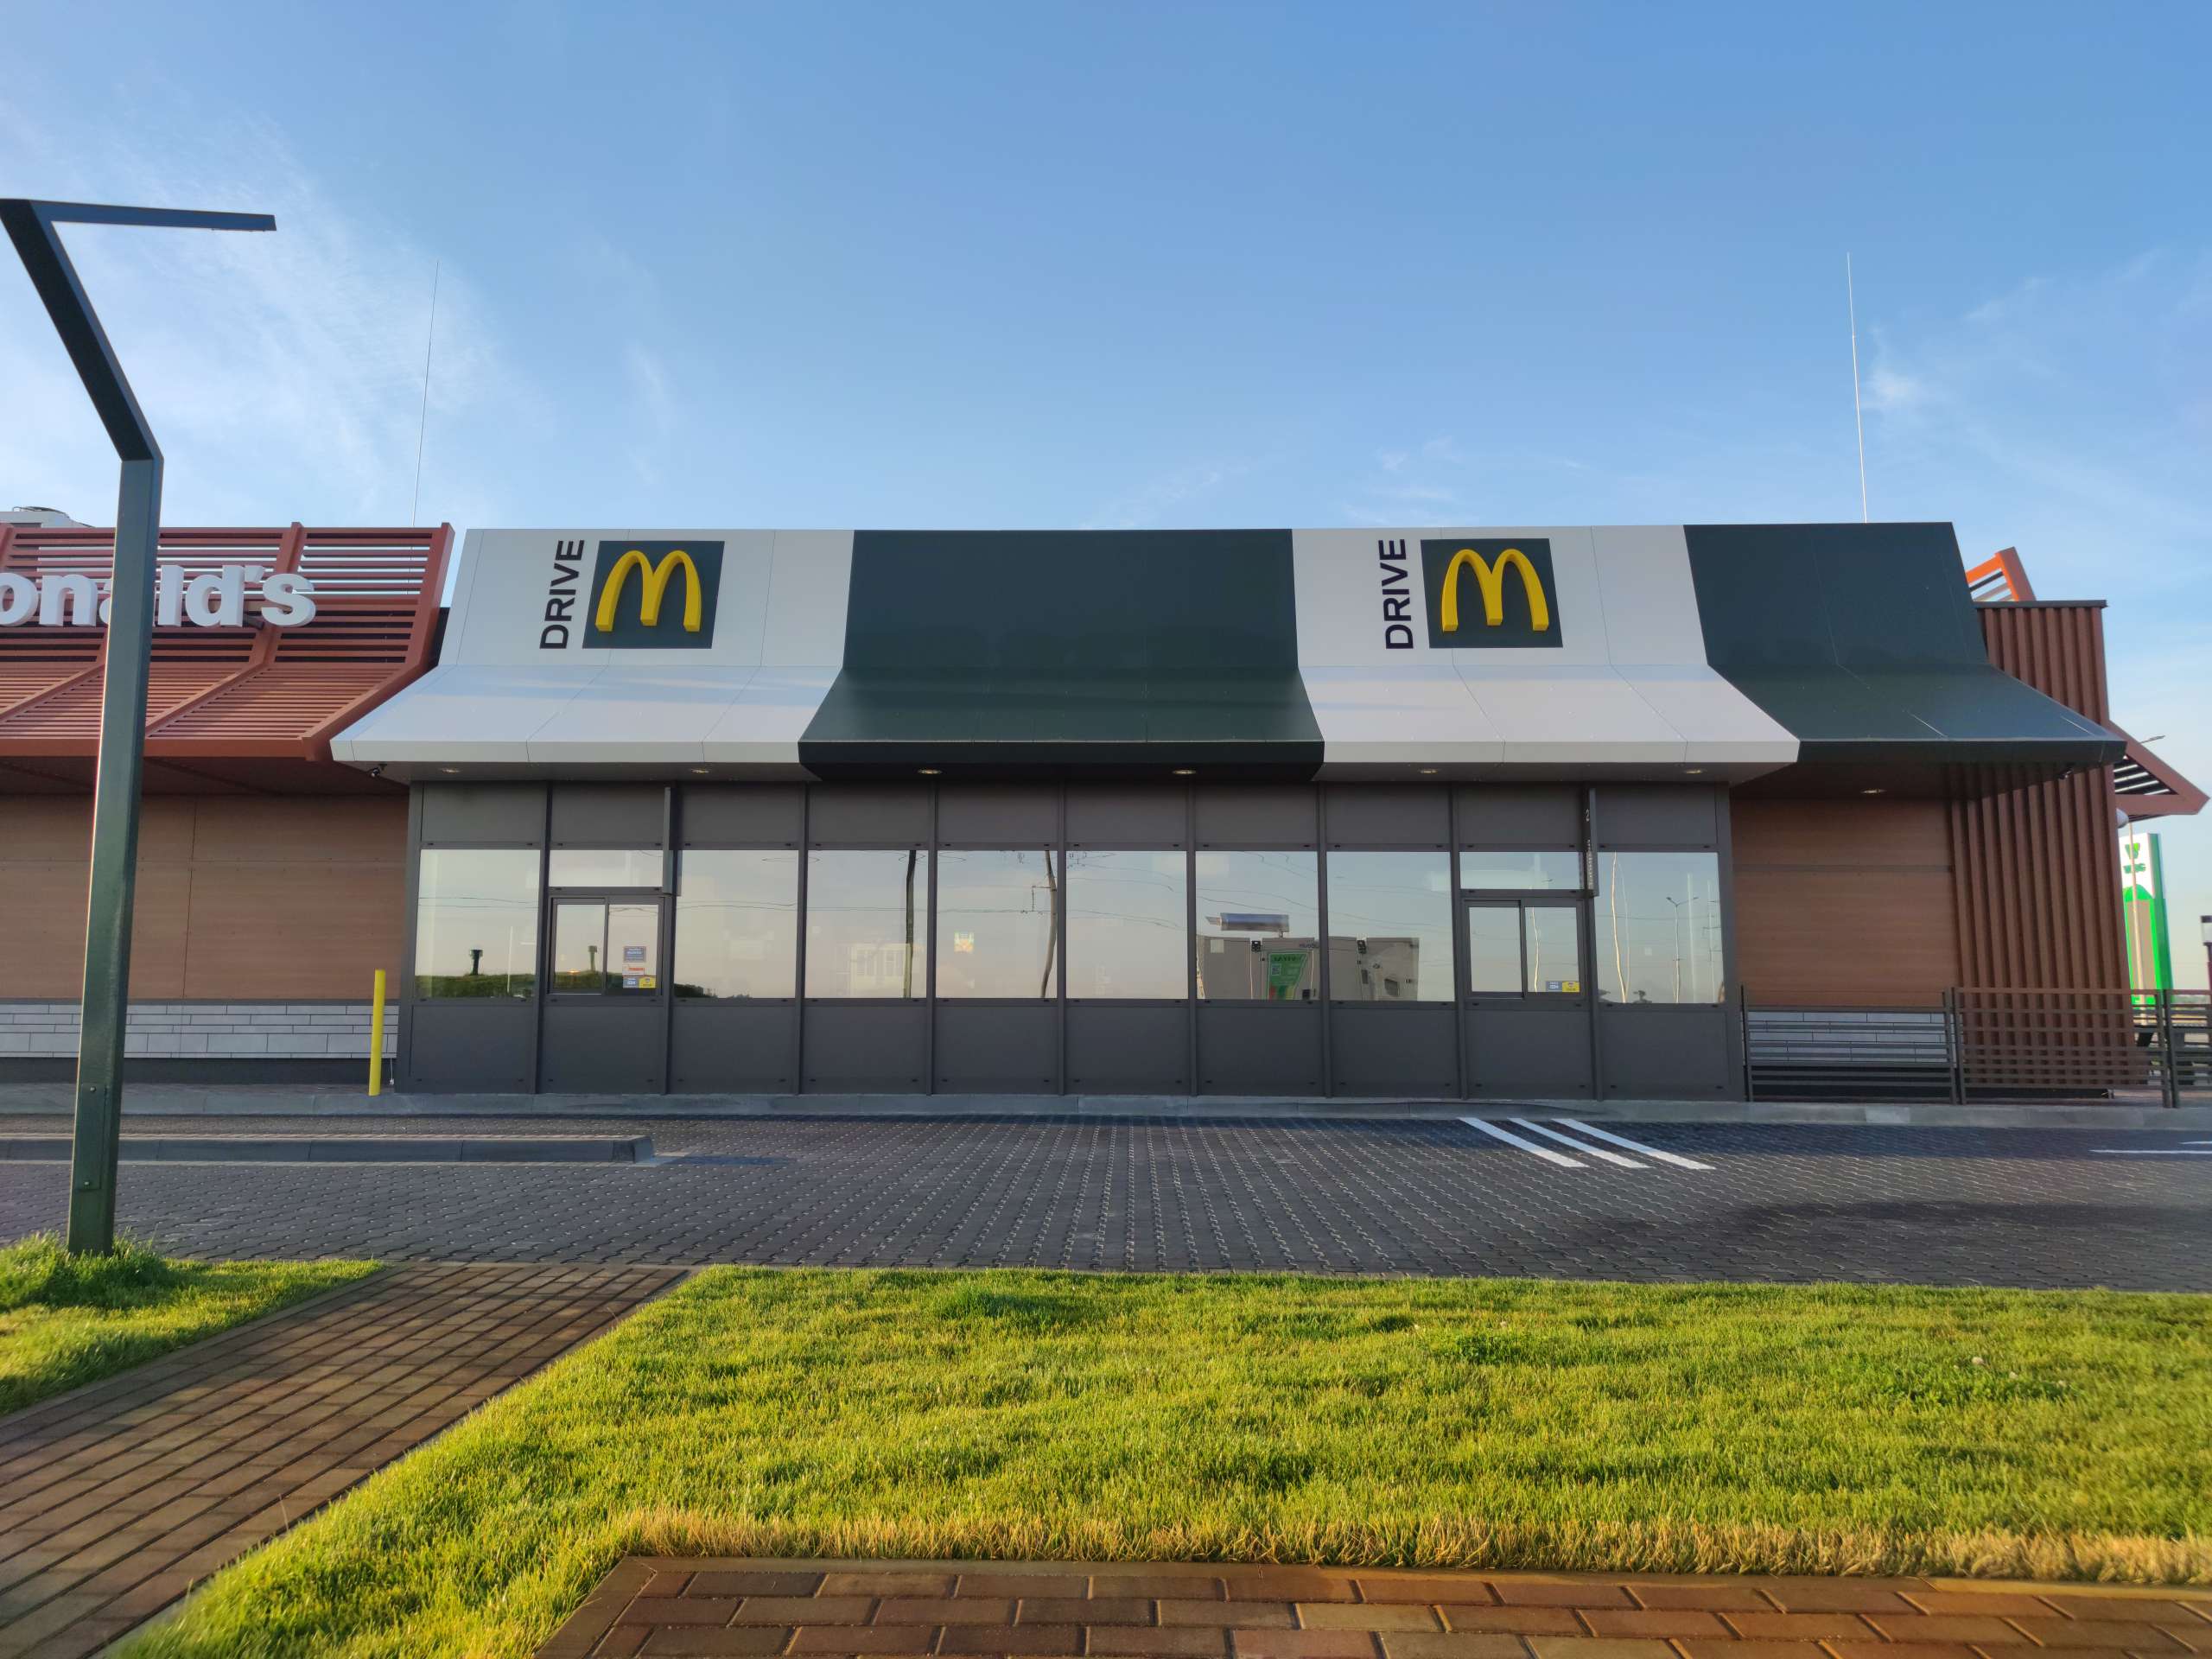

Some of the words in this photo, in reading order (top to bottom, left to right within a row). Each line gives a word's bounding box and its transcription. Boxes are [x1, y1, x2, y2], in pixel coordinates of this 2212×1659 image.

[0, 565, 316, 627] onld's
[539, 540, 585, 649] DRIVE
[1378, 539, 1414, 649] DRIVE
